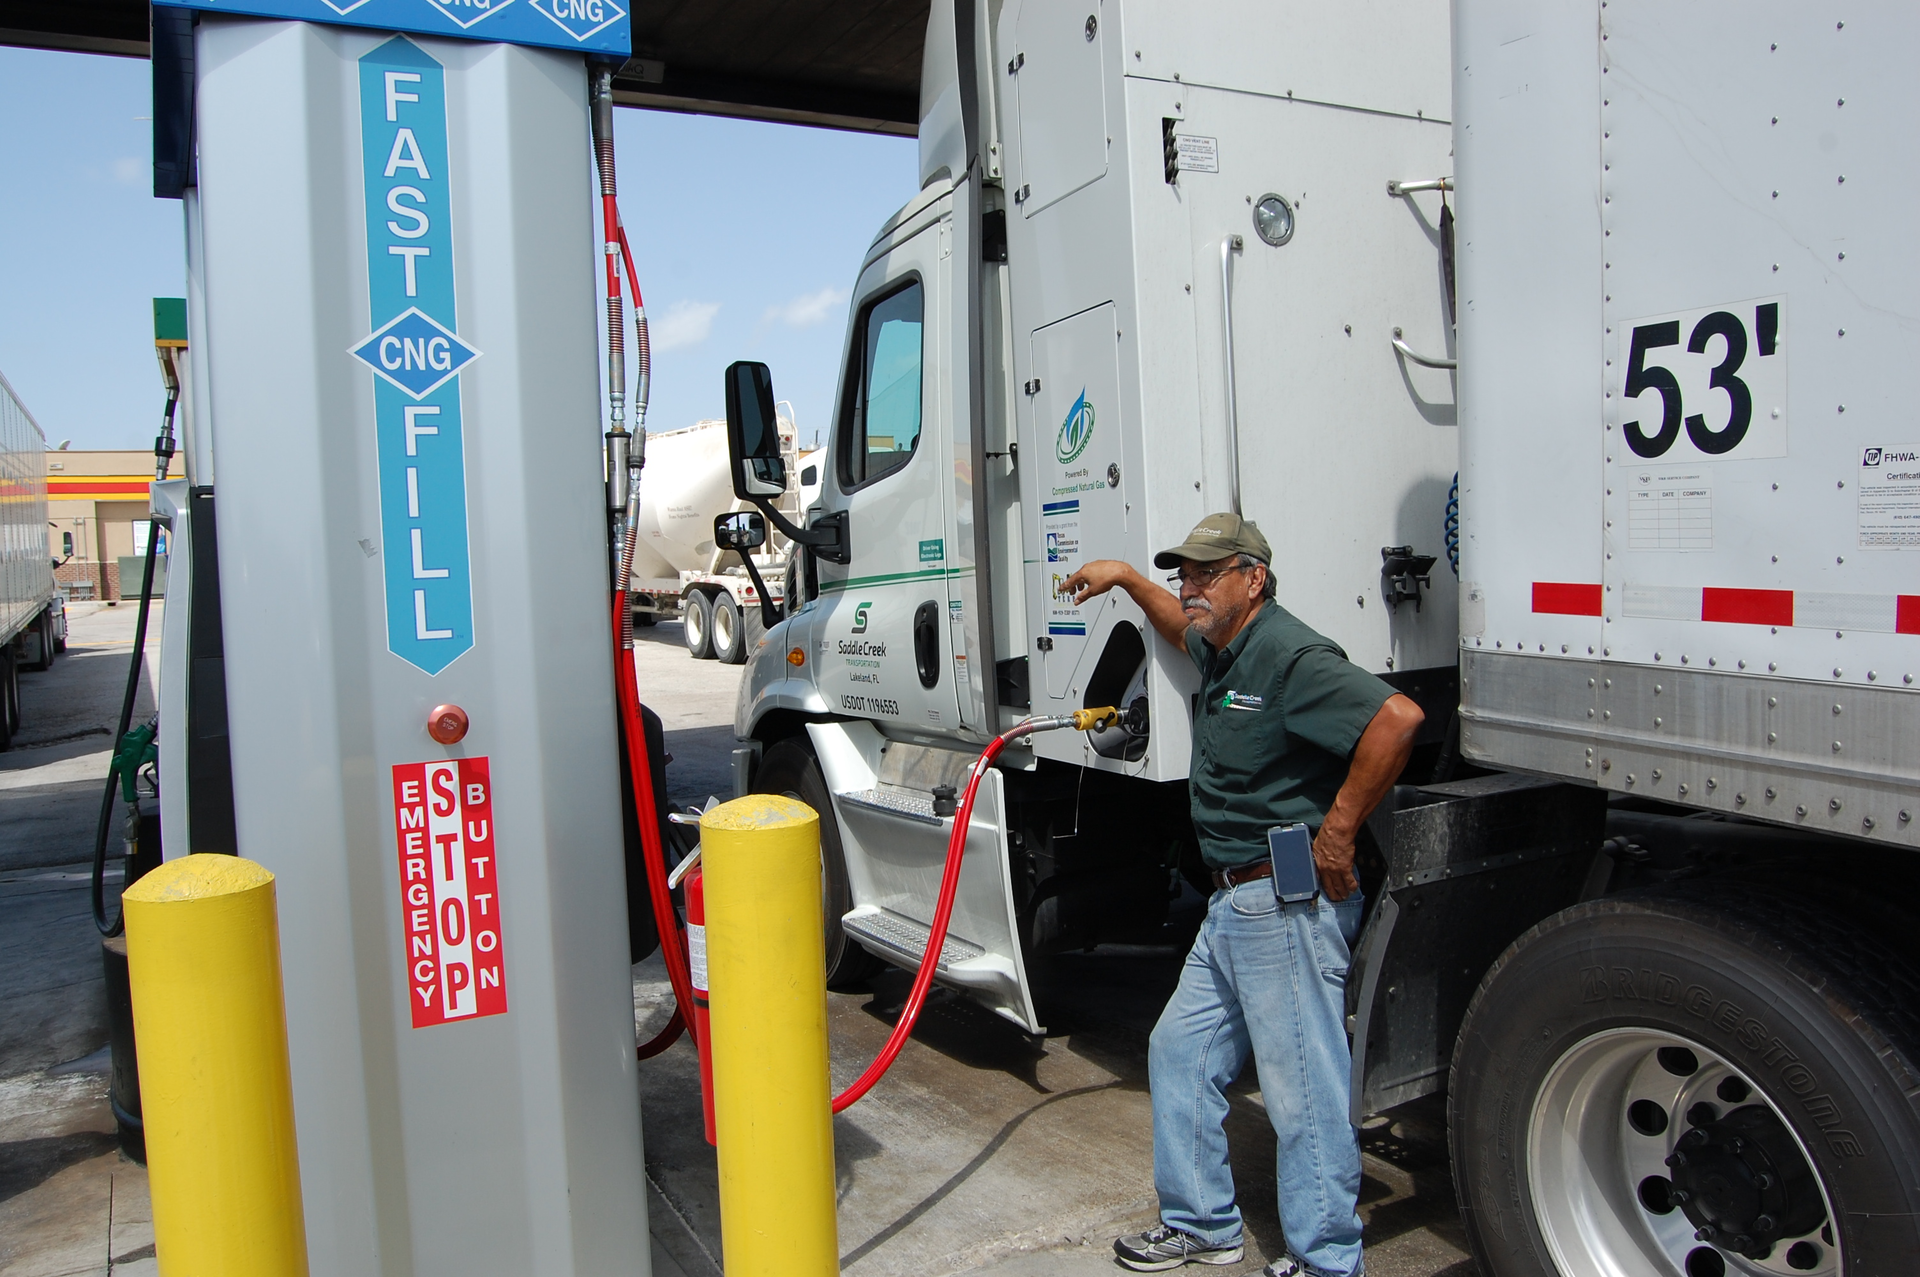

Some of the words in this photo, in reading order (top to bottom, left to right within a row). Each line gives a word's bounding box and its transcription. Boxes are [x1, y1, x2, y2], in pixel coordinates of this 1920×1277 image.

[552, 0, 604, 22] CNG
[382, 70, 432, 298] FAST
[379, 334, 452, 372] CNG
[1622, 302, 1778, 459] 53'
[1065, 470, 1083, 479] Powered
[1083, 468, 1089, 477] By
[1867, 452, 1879, 462] TIP
[1052, 485, 1078, 497] Compressed
[1078, 480, 1095, 492] Natural
[1095, 480, 1105, 489] Gas
[403, 405, 453, 641] FILL
[845, 658, 880, 668] TRANSPORTATION
[849, 672, 872, 684] Lakeland,
[873, 674, 880, 684] FL
[840, 694, 866, 711] USDOT
[867, 697, 899, 715] 1196553
[399, 780, 436, 1008] EMERGENCY
[431, 767, 470, 1011] STOP
[466, 782, 500, 989] BUTTON
[1579, 964, 1865, 1157] BRIDGESTONE
